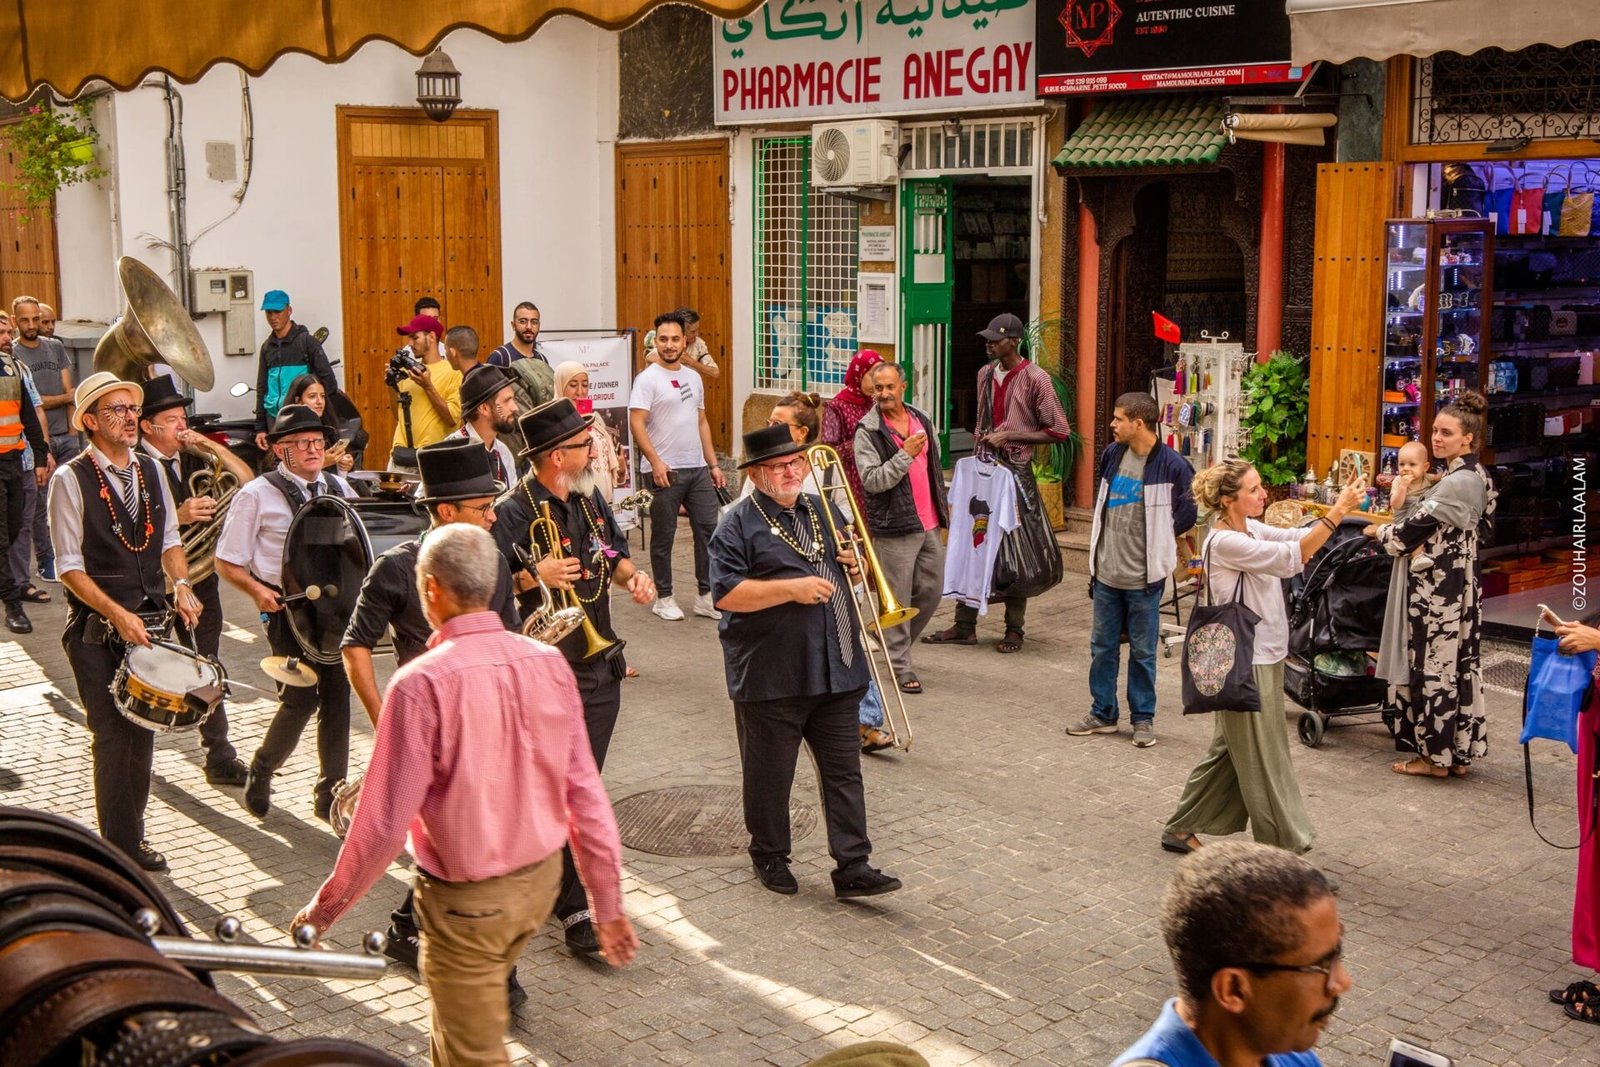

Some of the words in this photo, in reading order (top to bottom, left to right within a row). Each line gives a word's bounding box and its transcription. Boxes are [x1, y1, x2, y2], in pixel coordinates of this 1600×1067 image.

[1136, 8, 1193, 23] AUTENTHIC
[1195, 4, 1236, 18] CUISINE
[722, 56, 882, 112] PHARMACIE
[903, 41, 1033, 100] ANEGAY
[1142, 69, 1241, 81] CONTACT@MAMOUNIAPALACE.COM
[1156, 77, 1225, 87] MAMOUNIAPALACE.COM
[597, 381, 619, 389] DINNER
